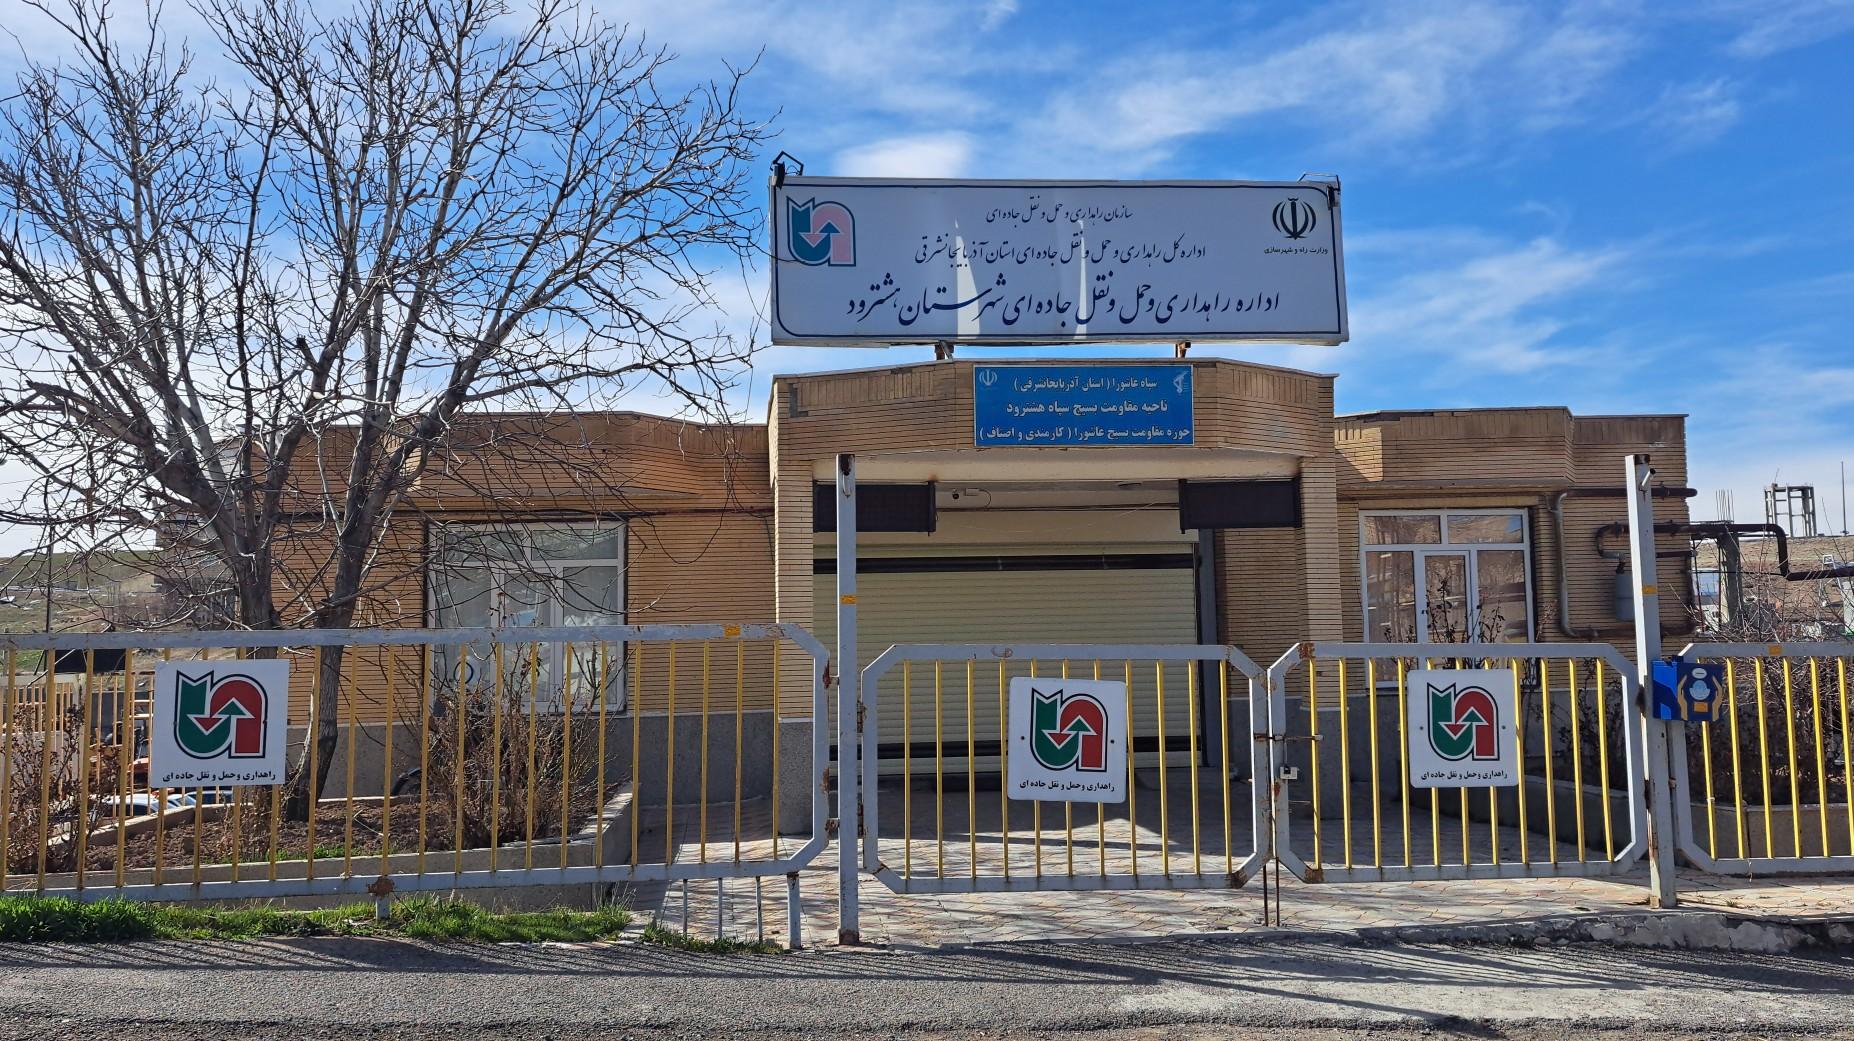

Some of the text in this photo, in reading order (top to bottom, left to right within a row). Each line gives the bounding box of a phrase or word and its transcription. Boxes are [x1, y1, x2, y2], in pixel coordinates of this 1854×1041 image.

[1021, 194, 1040, 223] نقل
[1046, 202, 1063, 223] حمل
[1103, 203, 1134, 222] سازمان
[1040, 210, 1046, 219] و
[1063, 210, 1069, 219] و
[1069, 206, 1103, 226] راهداری
[985, 240, 1015, 264] استان
[1060, 230, 1083, 265] نقل
[1090, 239, 1112, 264] حمل
[1162, 231, 1185, 263] کل
[1180, 243, 1206, 259] اداره
[1263, 246, 1293, 255] شهرسازی
[1299, 246, 1308, 255] راه
[1309, 246, 1329, 255] وزارت
[1083, 248, 1090, 259] و
[1112, 248, 1119, 259] و
[1119, 242, 1161, 268] راهداری
[846, 272, 901, 323] هشترود
[898, 272, 1007, 327] شهرستان
[1236, 291, 1280, 313] اداره
[1155, 292, 1231, 323] راهداری
[1140, 376, 1158, 392] سپاه
[1006, 399, 1168, 417] ناحیه مقاومت بسیج سپاه هشترود
[1018, 431, 1023, 441] و
[1074, 425, 1105, 441] عاشورا
[1107, 427, 1129, 440] بسیج
[1131, 425, 1165, 440] مقاومت
[162, 772, 174, 783] ای
[175, 771, 194, 780] جاده
[196, 771, 210, 781] نقل
[242, 770, 276, 781] راهداری
[1420, 771, 1430, 781] ای
[1430, 770, 1445, 778] جاده
[1446, 770, 1458, 780] نقل
[1482, 769, 1508, 780] راهداری
[1019, 779, 1029, 789] ای
[1030, 779, 1046, 788] جاده
[1047, 780, 1059, 790] نقل
[1086, 781, 1115, 792] راهداری
